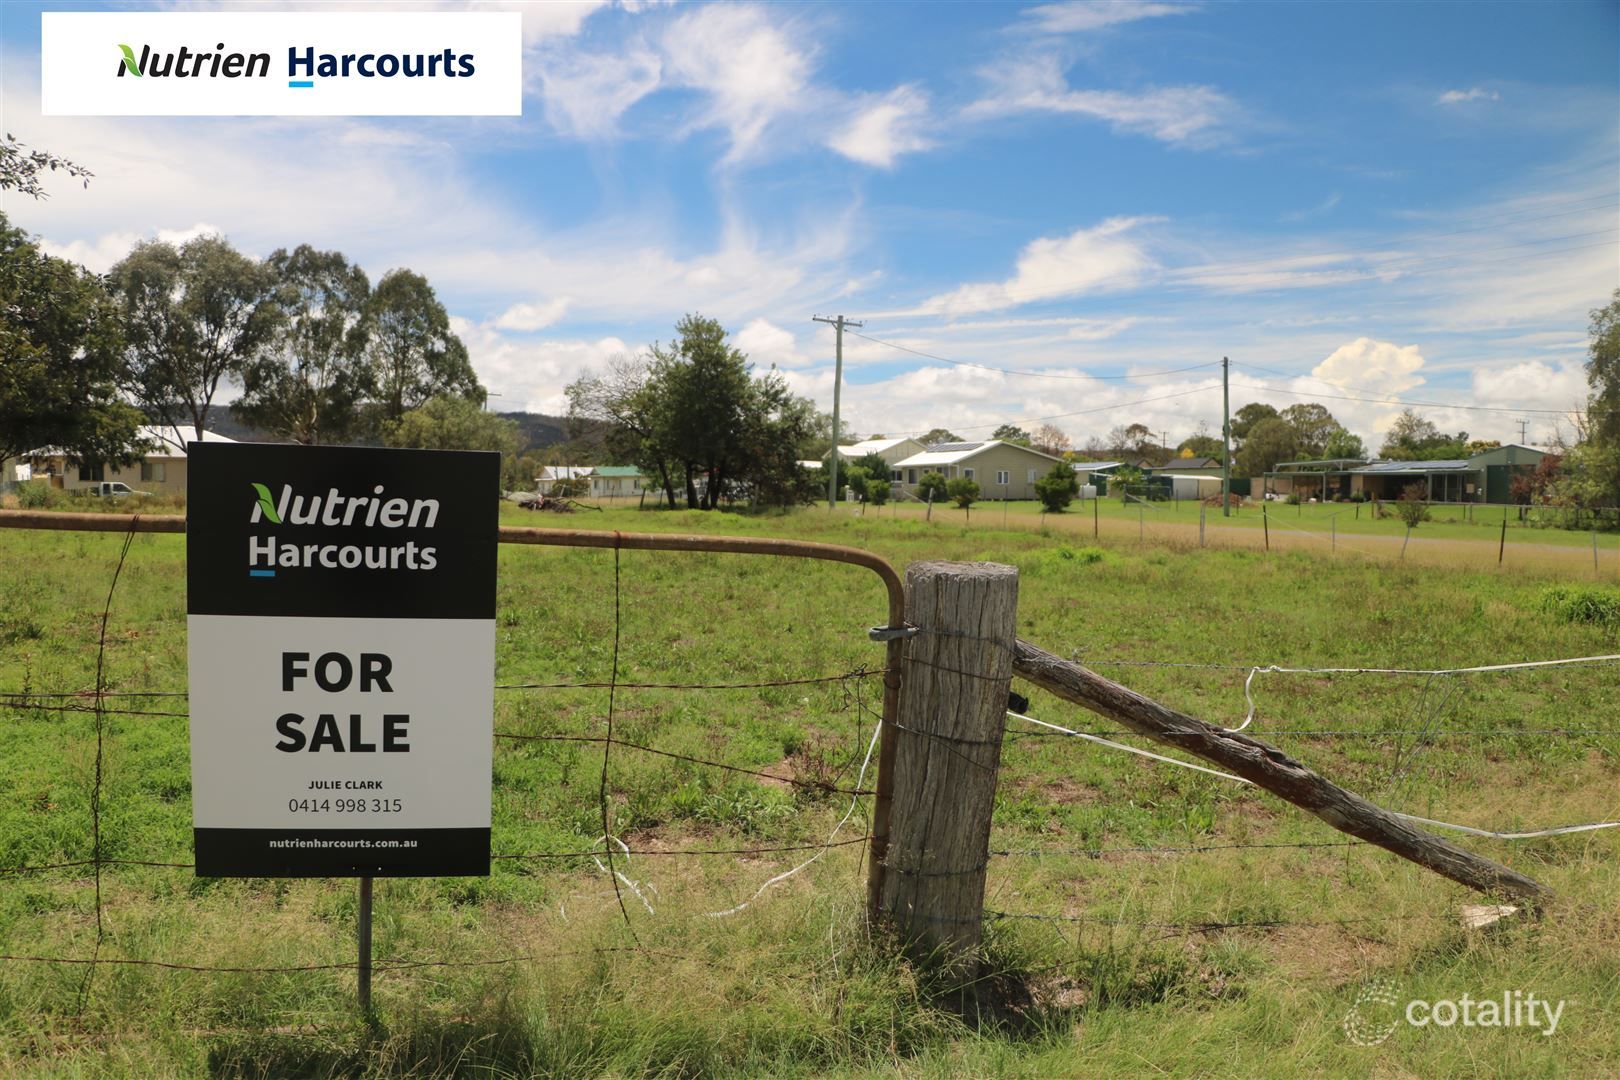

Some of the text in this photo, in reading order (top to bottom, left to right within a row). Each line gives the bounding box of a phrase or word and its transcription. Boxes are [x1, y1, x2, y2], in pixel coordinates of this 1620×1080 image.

[250, 483, 440, 528] Nutrien
[249, 535, 438, 570] Harcourts
[282, 652, 394, 693] FOR
[275, 713, 410, 753] SALE
[308, 780, 383, 790] JULIE CLARK
[288, 798, 402, 813] 0414 998 315
[269, 838, 418, 849] nutrienharcourts.com.au
